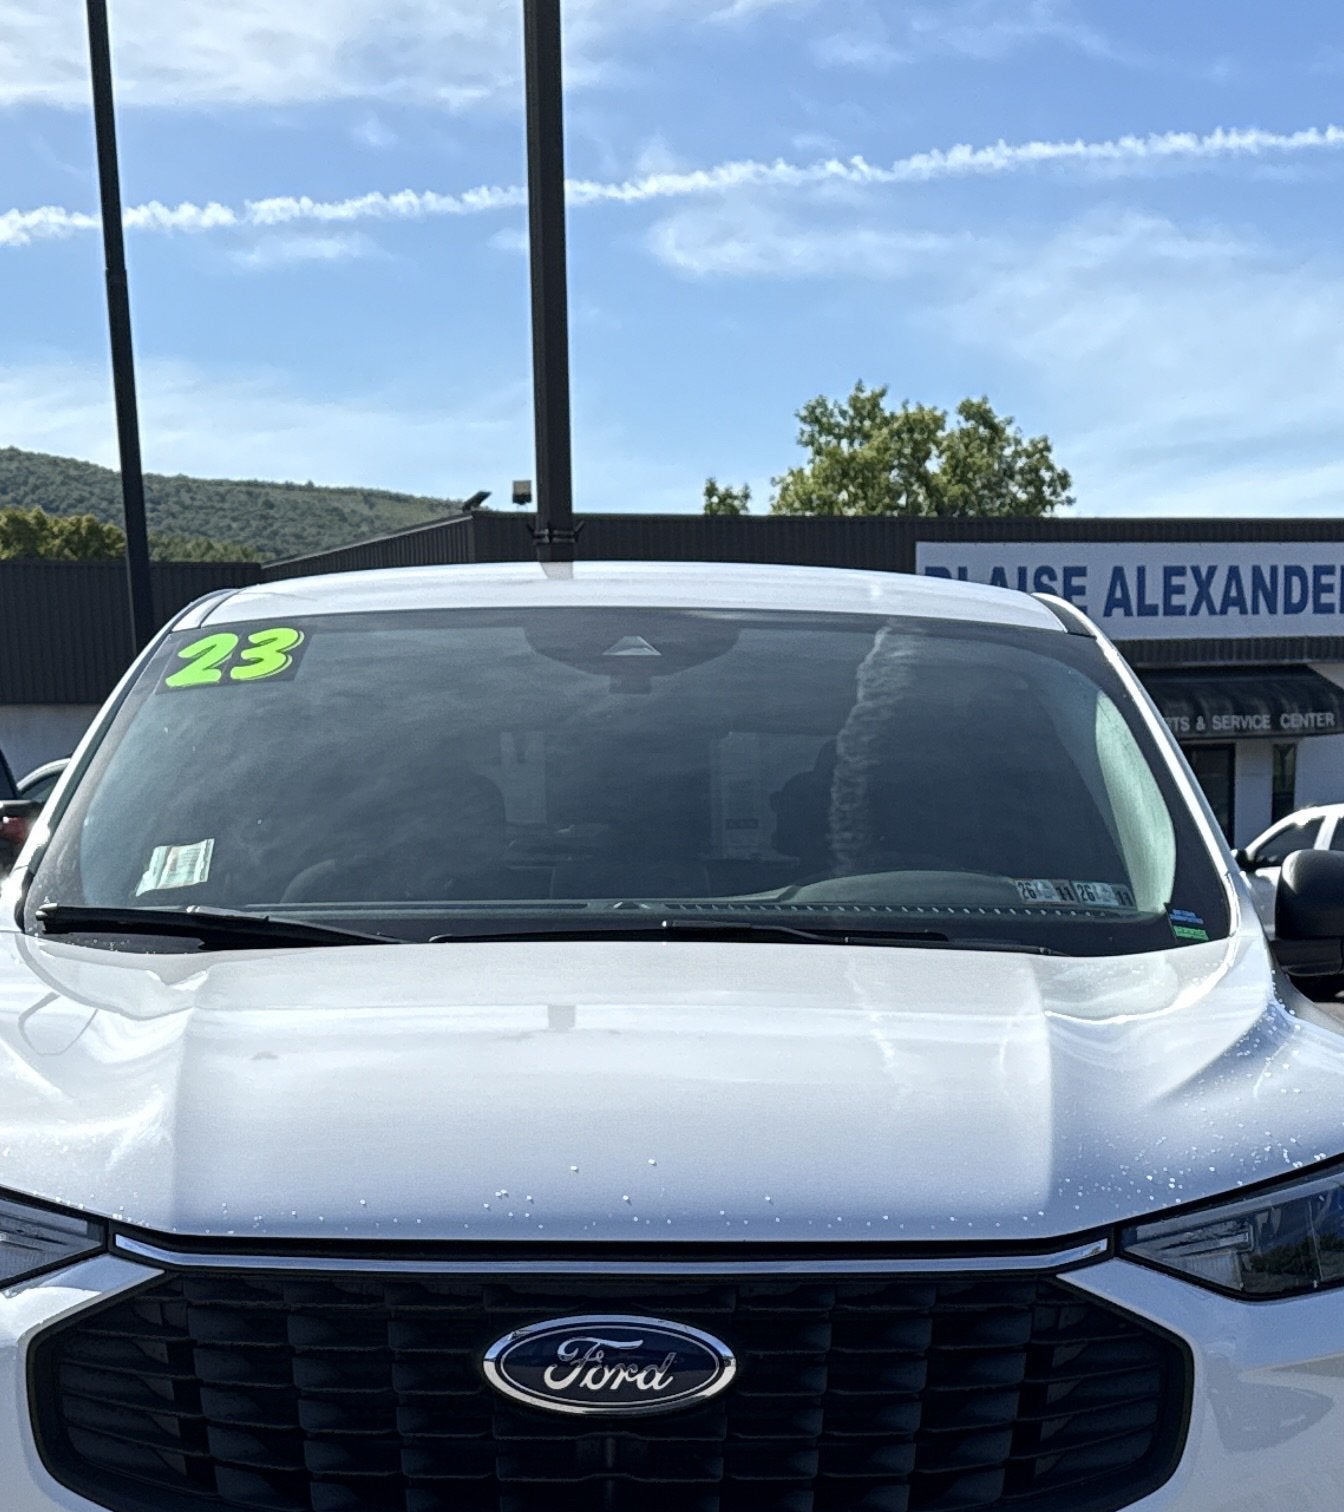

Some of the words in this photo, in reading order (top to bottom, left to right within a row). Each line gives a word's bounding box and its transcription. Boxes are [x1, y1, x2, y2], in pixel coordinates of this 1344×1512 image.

[925, 564, 1088, 616] ISE
[165, 627, 305, 688] 23
[1196, 715, 1206, 731] &
[1212, 714, 1271, 730] SERVICE
[1280, 712, 1335, 728] CENTER
[544, 1336, 677, 1390] Ford
